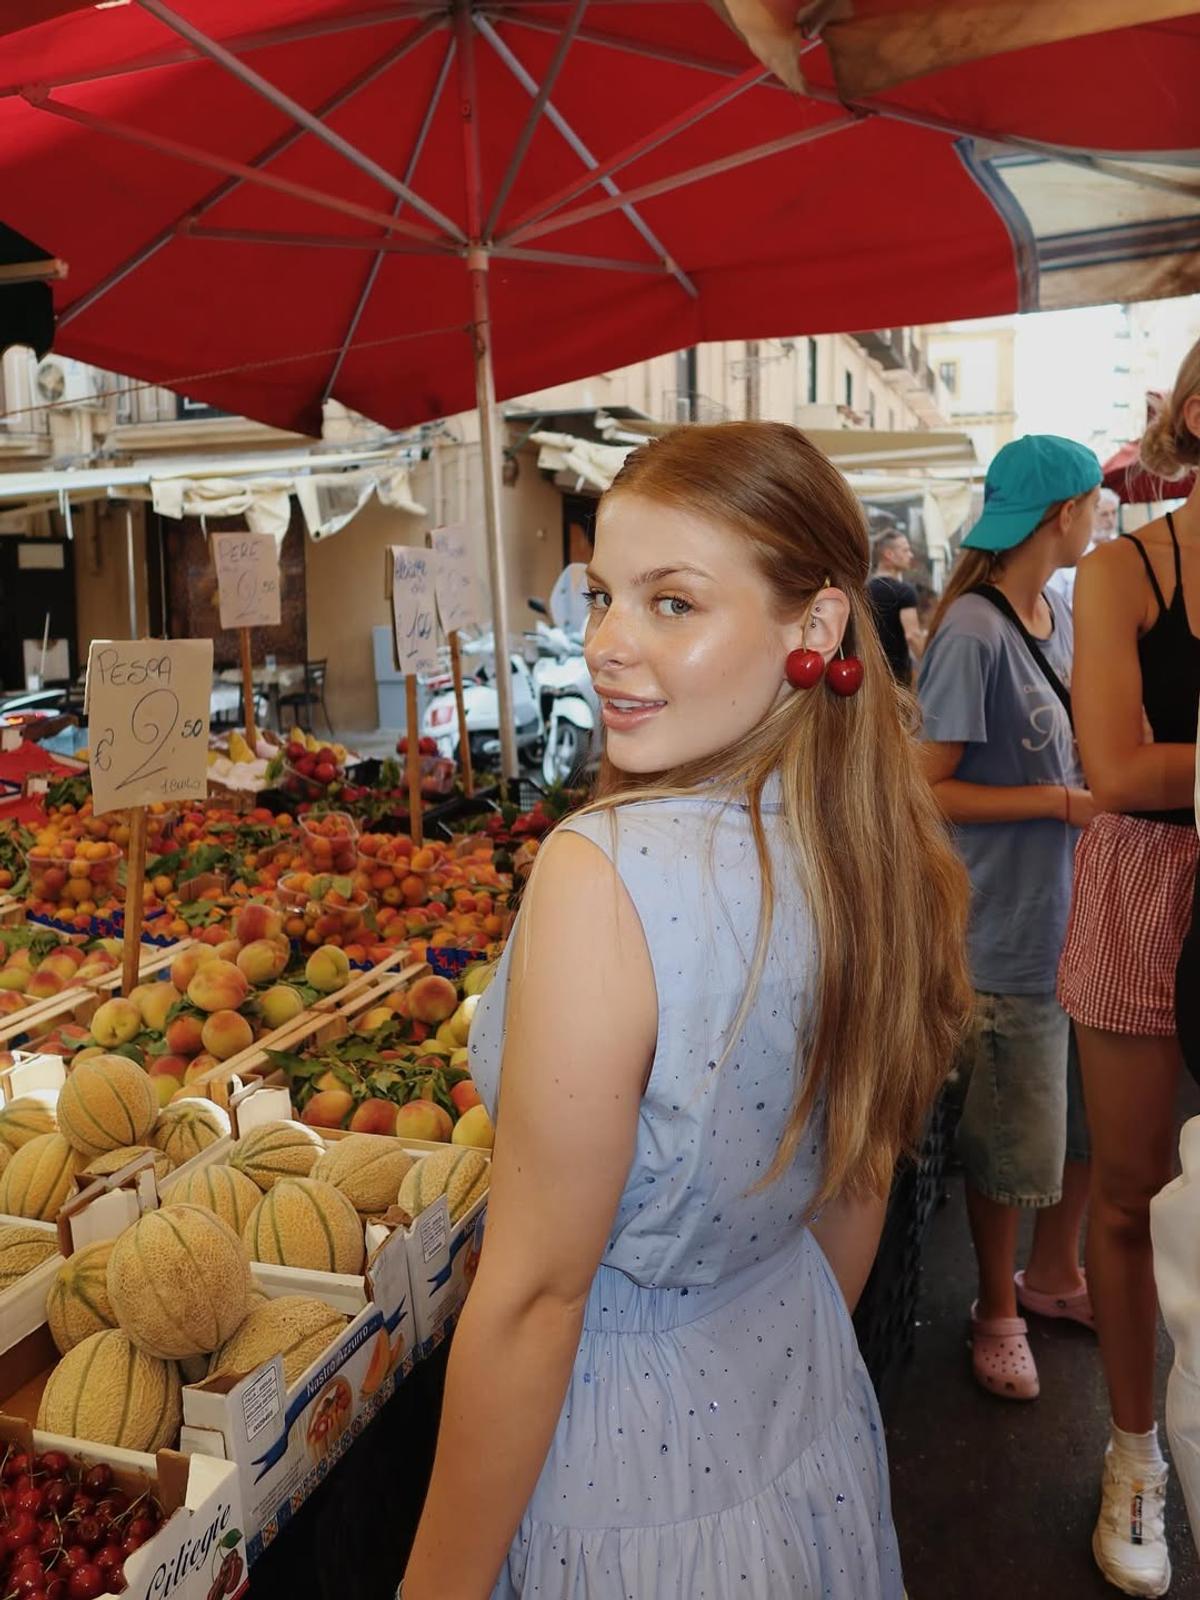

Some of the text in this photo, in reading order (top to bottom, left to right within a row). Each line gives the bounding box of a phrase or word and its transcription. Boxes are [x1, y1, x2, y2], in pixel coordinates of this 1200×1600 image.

[306, 1325, 368, 1397] Nastro Azzurro
[146, 1503, 232, 1600] Ciliegie
